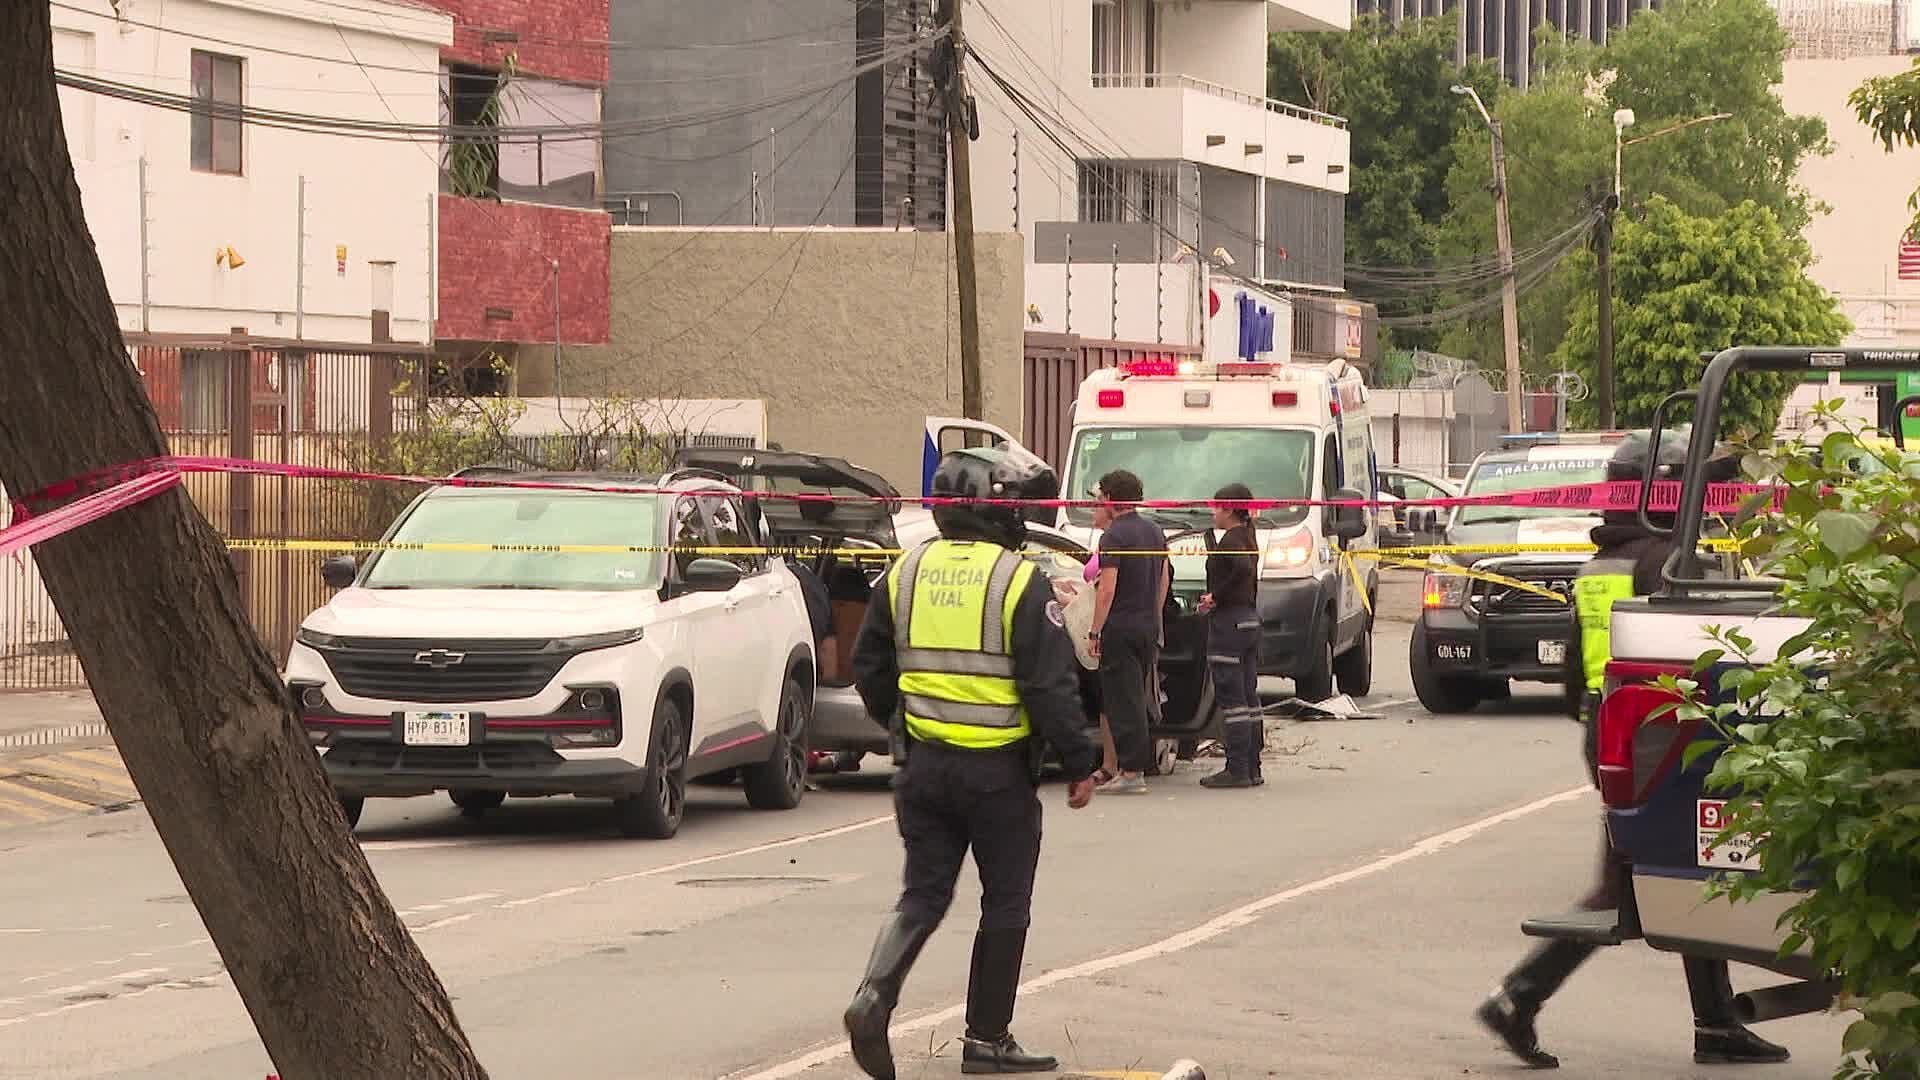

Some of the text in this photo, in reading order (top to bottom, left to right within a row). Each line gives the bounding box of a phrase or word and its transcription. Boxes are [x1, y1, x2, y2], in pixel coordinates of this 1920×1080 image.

[919, 567, 985, 587] POLICIA
[929, 590, 966, 607] VIAL
[1437, 645, 1472, 659] GDL-167
